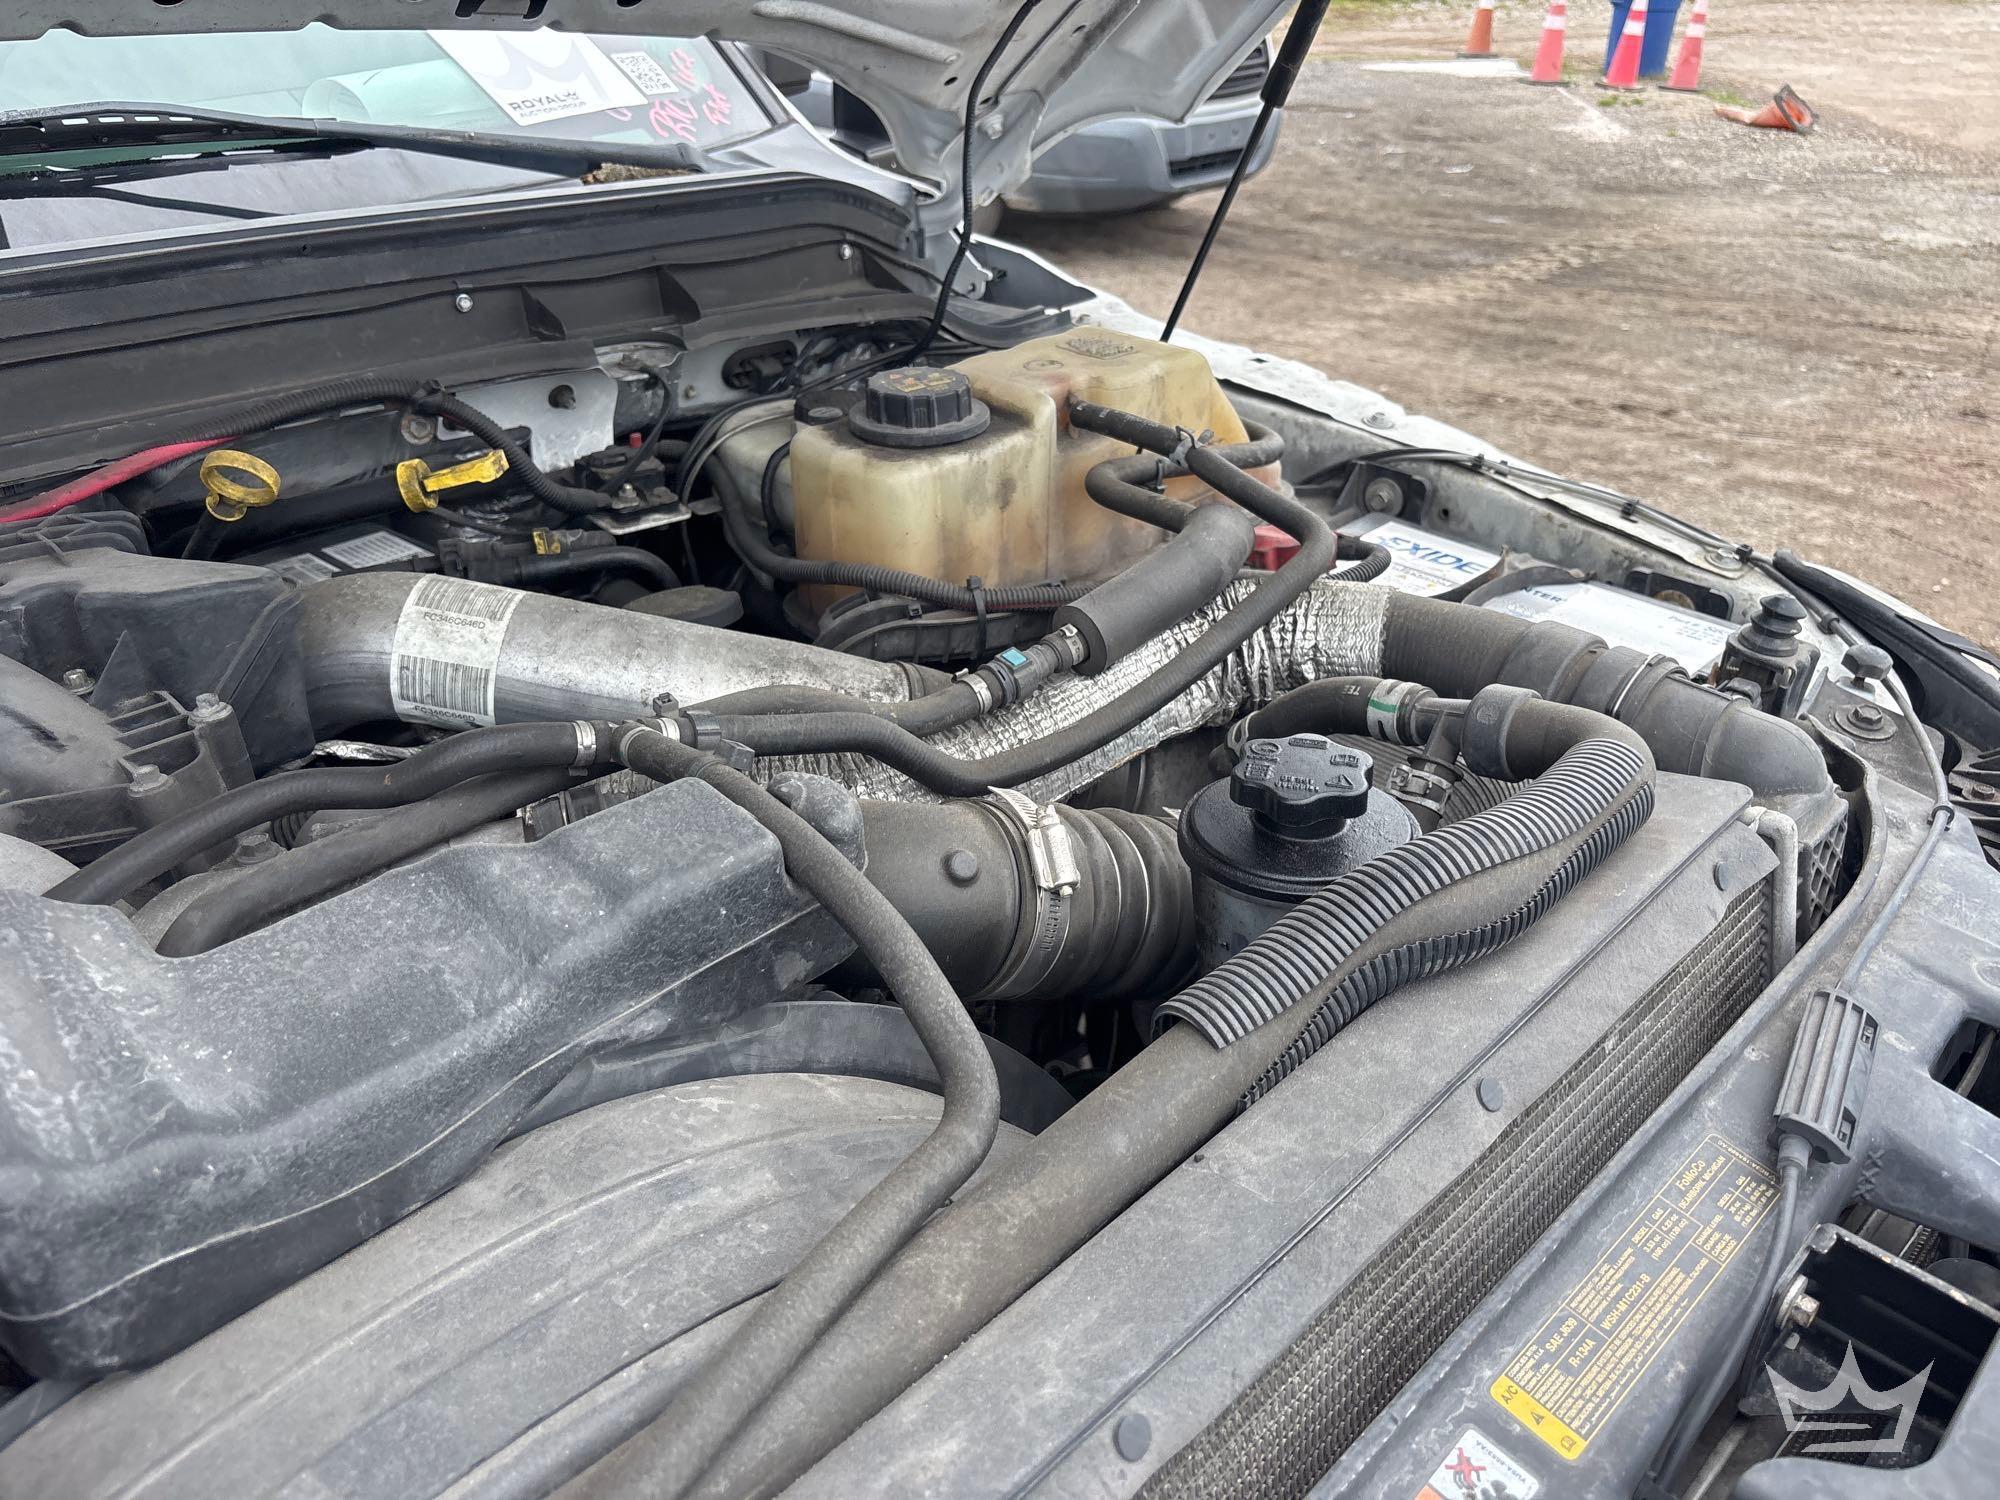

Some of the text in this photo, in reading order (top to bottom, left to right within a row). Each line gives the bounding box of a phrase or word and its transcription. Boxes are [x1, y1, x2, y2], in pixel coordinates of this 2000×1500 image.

[508, 93, 566, 111] ROYAL
[1388, 536, 1489, 575] EXIDE
[1675, 1157, 1706, 1190] FoMoCo
[1701, 1154, 1726, 1181] MICHIGAN
[1734, 1174, 1746, 1186] GAS
[1631, 1207, 1663, 1244] DIESEL GAS
[1599, 1272, 1651, 1331] WSH-M1C231-B
[1544, 1315, 1578, 1353] SAE J639
[1567, 1336, 1596, 1368] R-134A
[1499, 1383, 1519, 1404] A/C
